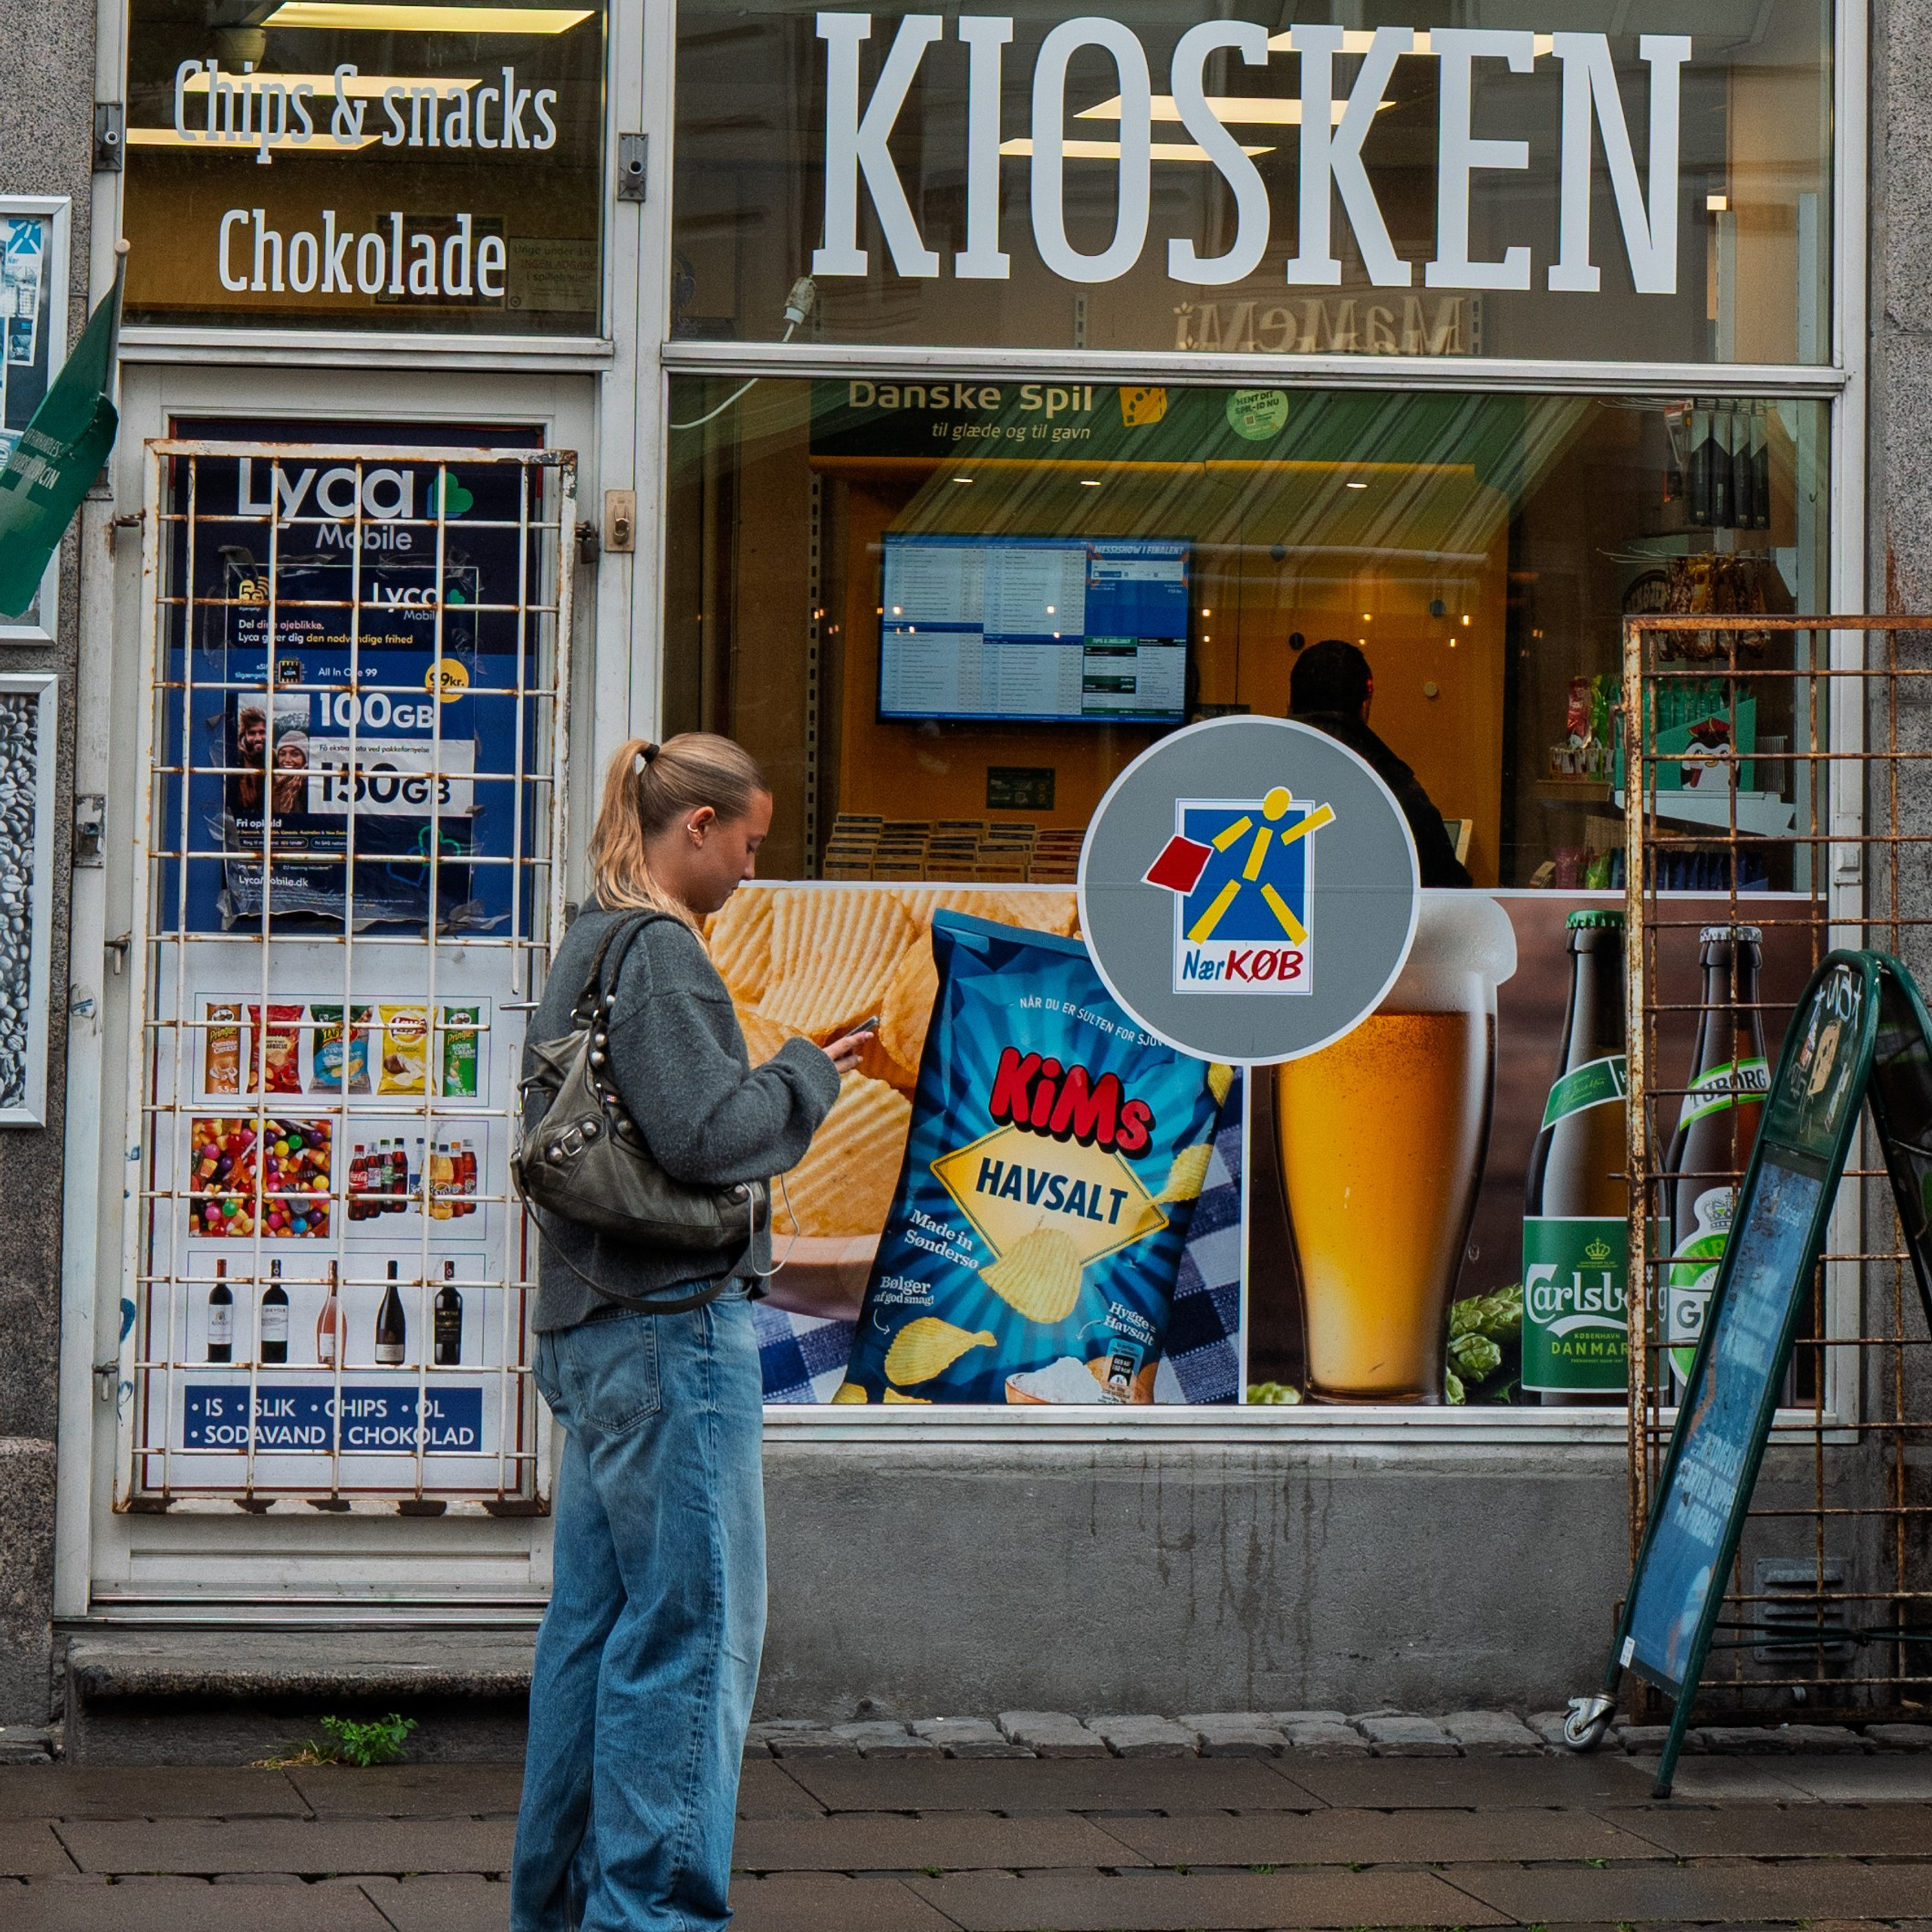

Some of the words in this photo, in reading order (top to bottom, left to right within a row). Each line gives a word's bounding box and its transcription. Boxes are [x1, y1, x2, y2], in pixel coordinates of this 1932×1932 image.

[175, 60, 313, 164] Chips
[332, 63, 368, 145] &
[382, 67, 556, 149] snacks
[813, 12, 1692, 294] KIOSKEN
[219, 208, 506, 297] Chokolade
[849, 380, 1001, 409] Danske
[1020, 384, 1093, 419] Spil
[932, 422, 948, 437] til
[952, 422, 1001, 441] glæde
[1006, 426, 1026, 441] og
[1032, 423, 1048, 439] til
[1051, 426, 1091, 442] gavn
[238, 457, 414, 528] Lyca
[315, 524, 413, 549] Mobile
[238, 620, 254, 629] Del
[238, 632, 259, 643] Lyca
[288, 632, 304, 644] dig
[306, 634, 325, 642] den
[385, 635, 414, 644] frihed
[318, 668, 331, 676] All
[333, 668, 341, 676] In
[320, 693, 434, 728] 100GB
[235, 819, 248, 828] Fri
[1020, 995, 1042, 1009] NÅR
[1045, 998, 1060, 1011] DU
[1062, 1002, 1076, 1016] ER
[1077, 1008, 1114, 1034] SULTEN
[1115, 1026, 1135, 1042] FOR
[975, 1157, 1128, 1226] HAVSALT
[909, 1209, 955, 1240] Made
[955, 1231, 974, 1251] in
[904, 1229, 979, 1270] Søndersø
[873, 1291, 886, 1303] af
[884, 1293, 903, 1305] god
[879, 1275, 931, 1296] Bølger
[1103, 1315, 1155, 1346] Havsalt
[1109, 1300, 1149, 1331] Hygge
[205, 1398, 223, 1418] IS
[254, 1398, 296, 1418] SLIK
[325, 1398, 388, 1419] CHIPS
[205, 1425, 326, 1444] SODAVAND
[348, 1426, 475, 1446] CHOKOLAD
